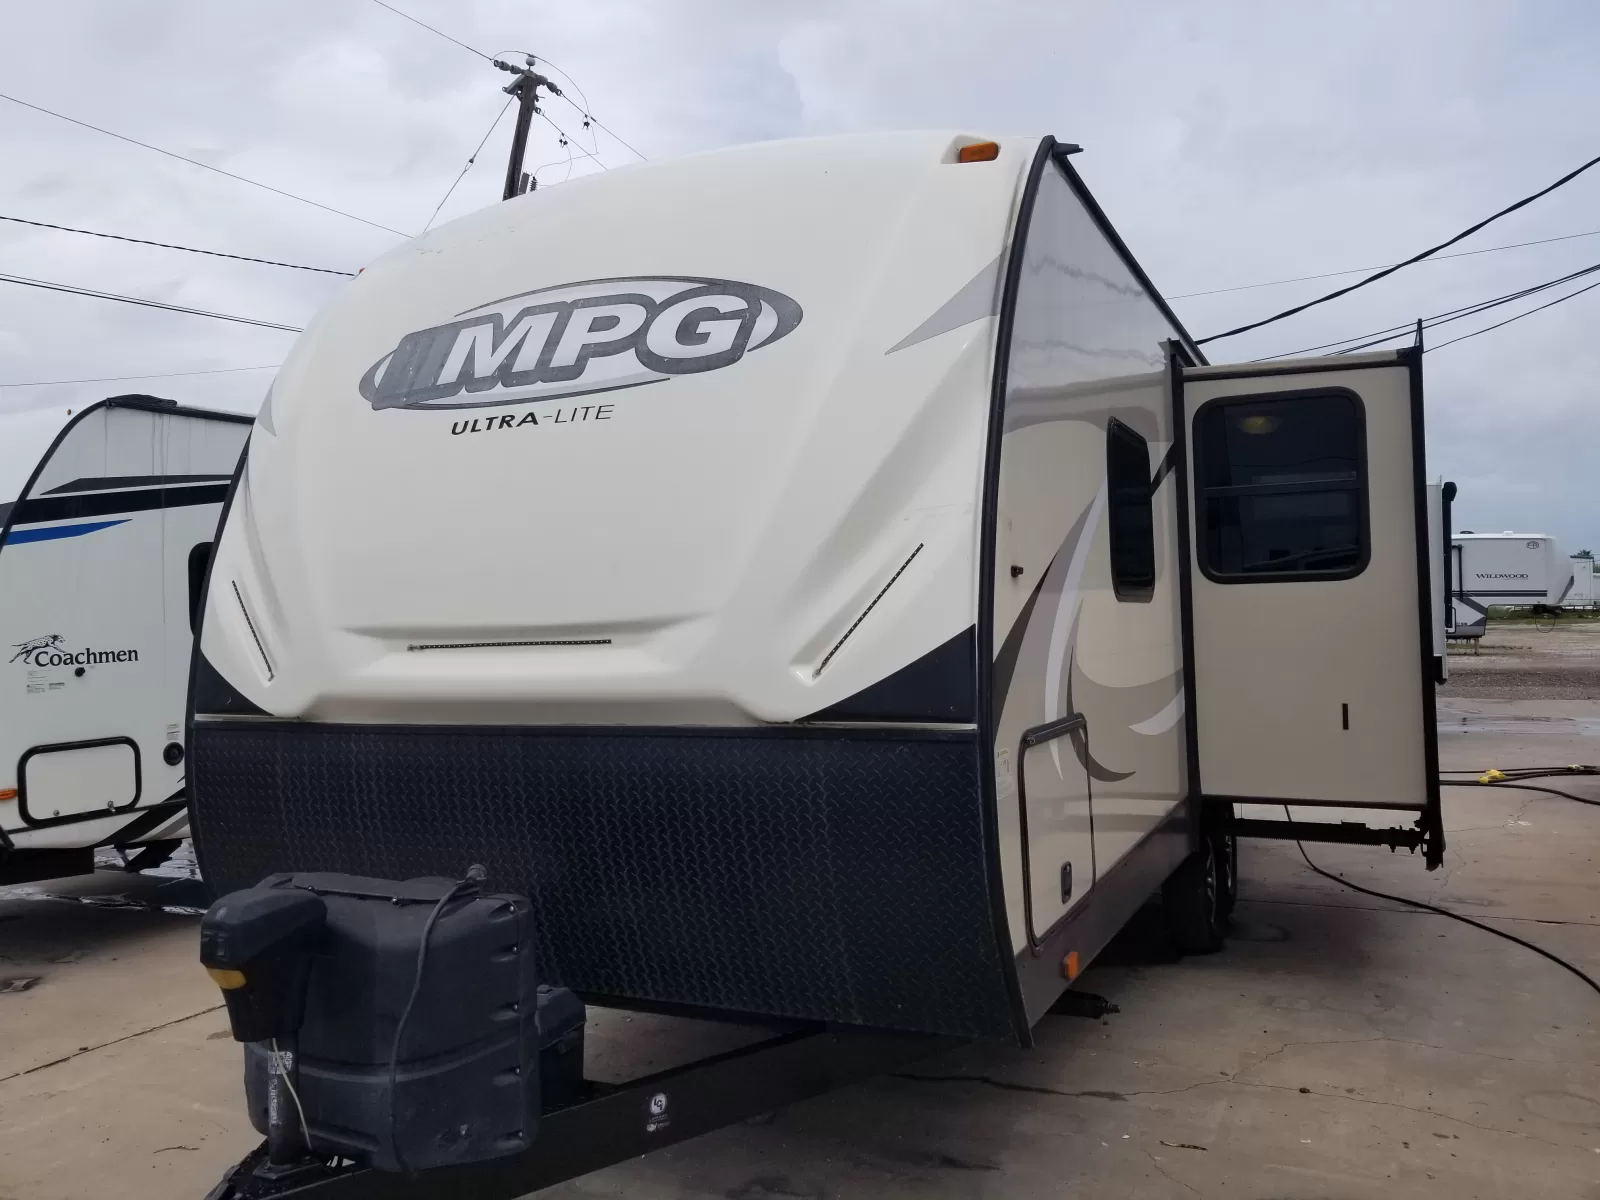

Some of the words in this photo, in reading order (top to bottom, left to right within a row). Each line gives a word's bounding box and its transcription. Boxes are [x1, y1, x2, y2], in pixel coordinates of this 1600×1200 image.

[435, 293, 751, 387] MPG
[451, 404, 616, 436] ULTRA-LITE
[34, 647, 139, 667] Coachmen
